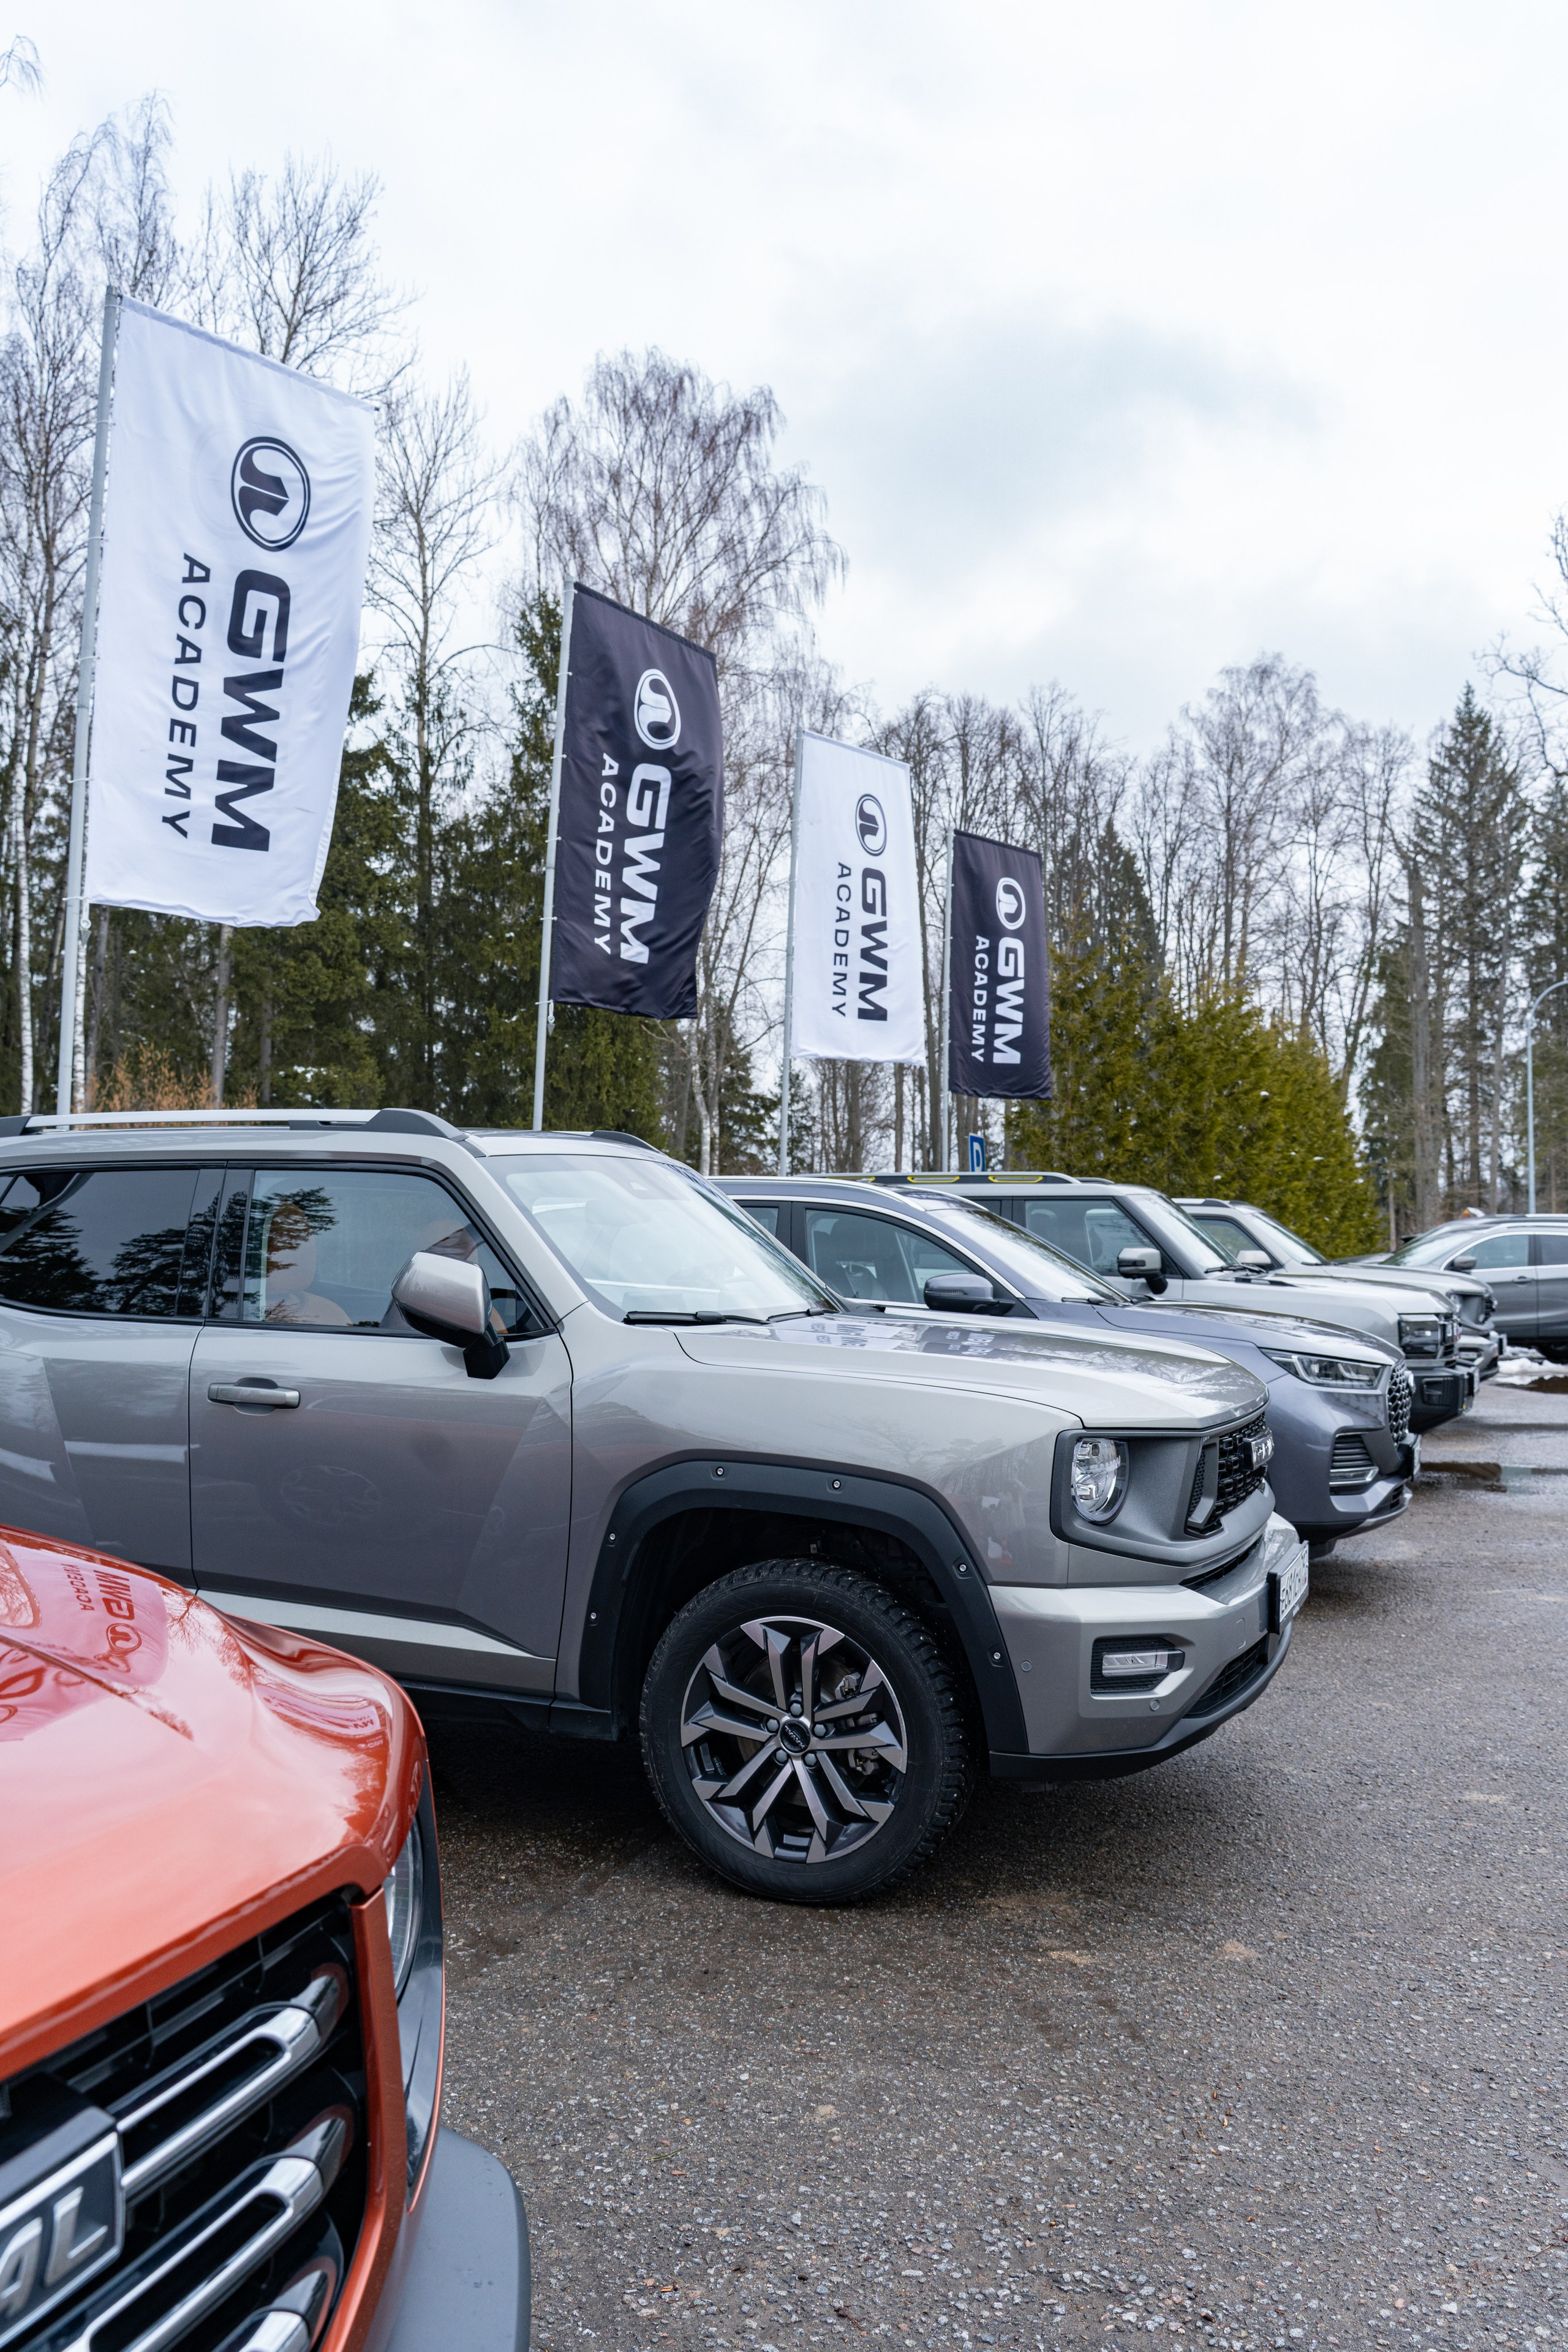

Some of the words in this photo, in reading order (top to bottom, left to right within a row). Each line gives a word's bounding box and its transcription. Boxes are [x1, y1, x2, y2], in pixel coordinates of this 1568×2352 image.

[162, 552, 211, 839] ACADEMY
[211, 569, 291, 852] GWM
[594, 752, 619, 955] ACADEMY
[620, 763, 672, 964] GWM
[831, 862, 852, 1018] ACADEMY
[858, 867, 888, 1022] GWM
[971, 935, 990, 1063] ACADEMY
[992, 937, 1025, 1065] GWM
